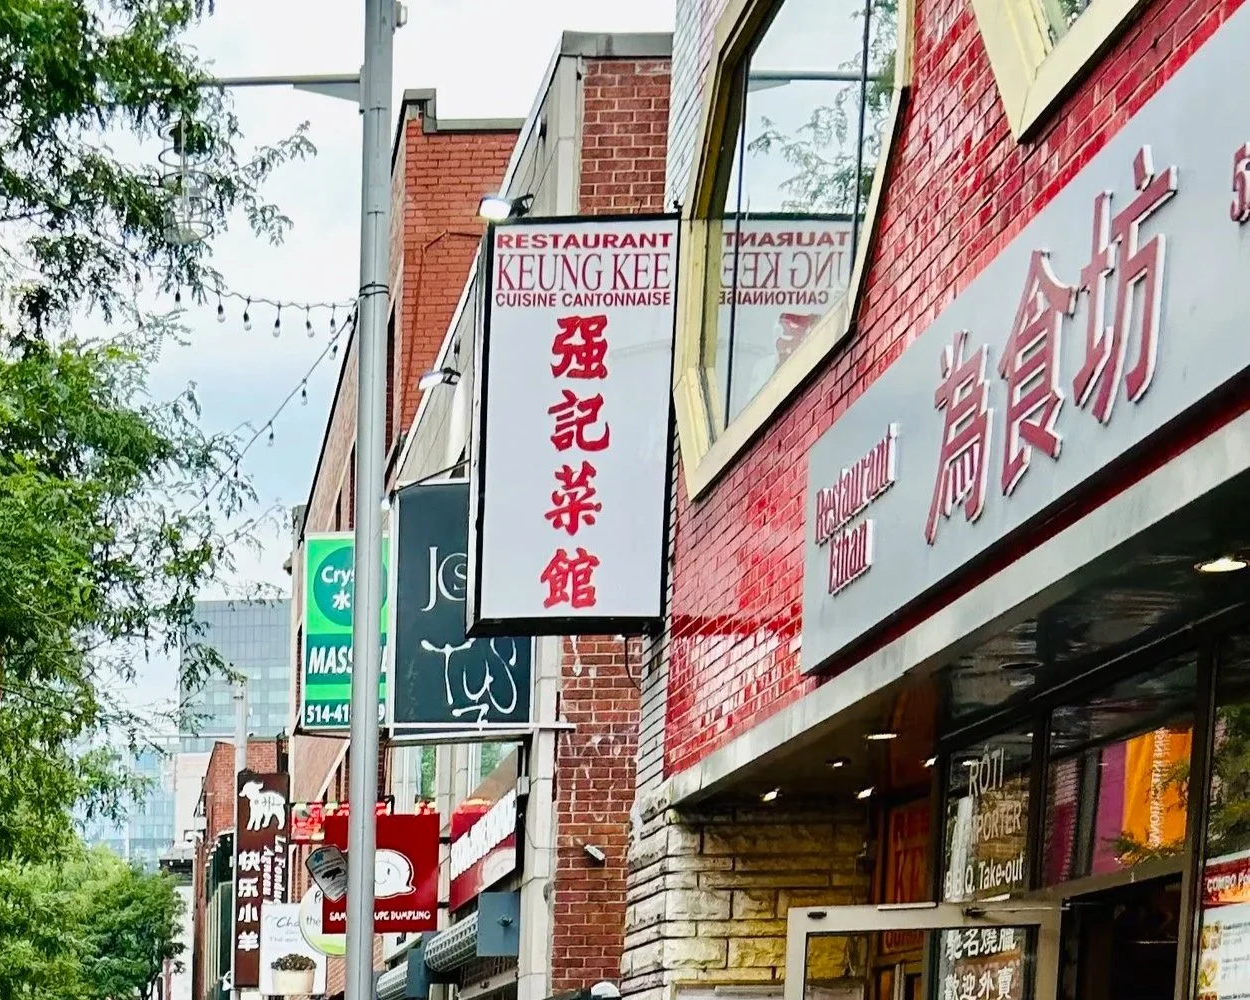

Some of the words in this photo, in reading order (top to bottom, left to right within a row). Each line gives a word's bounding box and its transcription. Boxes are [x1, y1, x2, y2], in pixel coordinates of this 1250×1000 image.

[497, 233, 673, 249] RESTAURANT
[496, 253, 603, 291] KEUNG
[611, 252, 671, 290] KEE
[496, 292, 556, 308] CUISINE
[562, 291, 671, 307] CANTONNAISE
[815, 422, 898, 548] Restaurant
[829, 518, 874, 597] Ethan
[978, 852, 1024, 891] Take-out
[237, 850, 261, 952] 快乐小羊
[391, 910, 431, 921] DUMPLING
